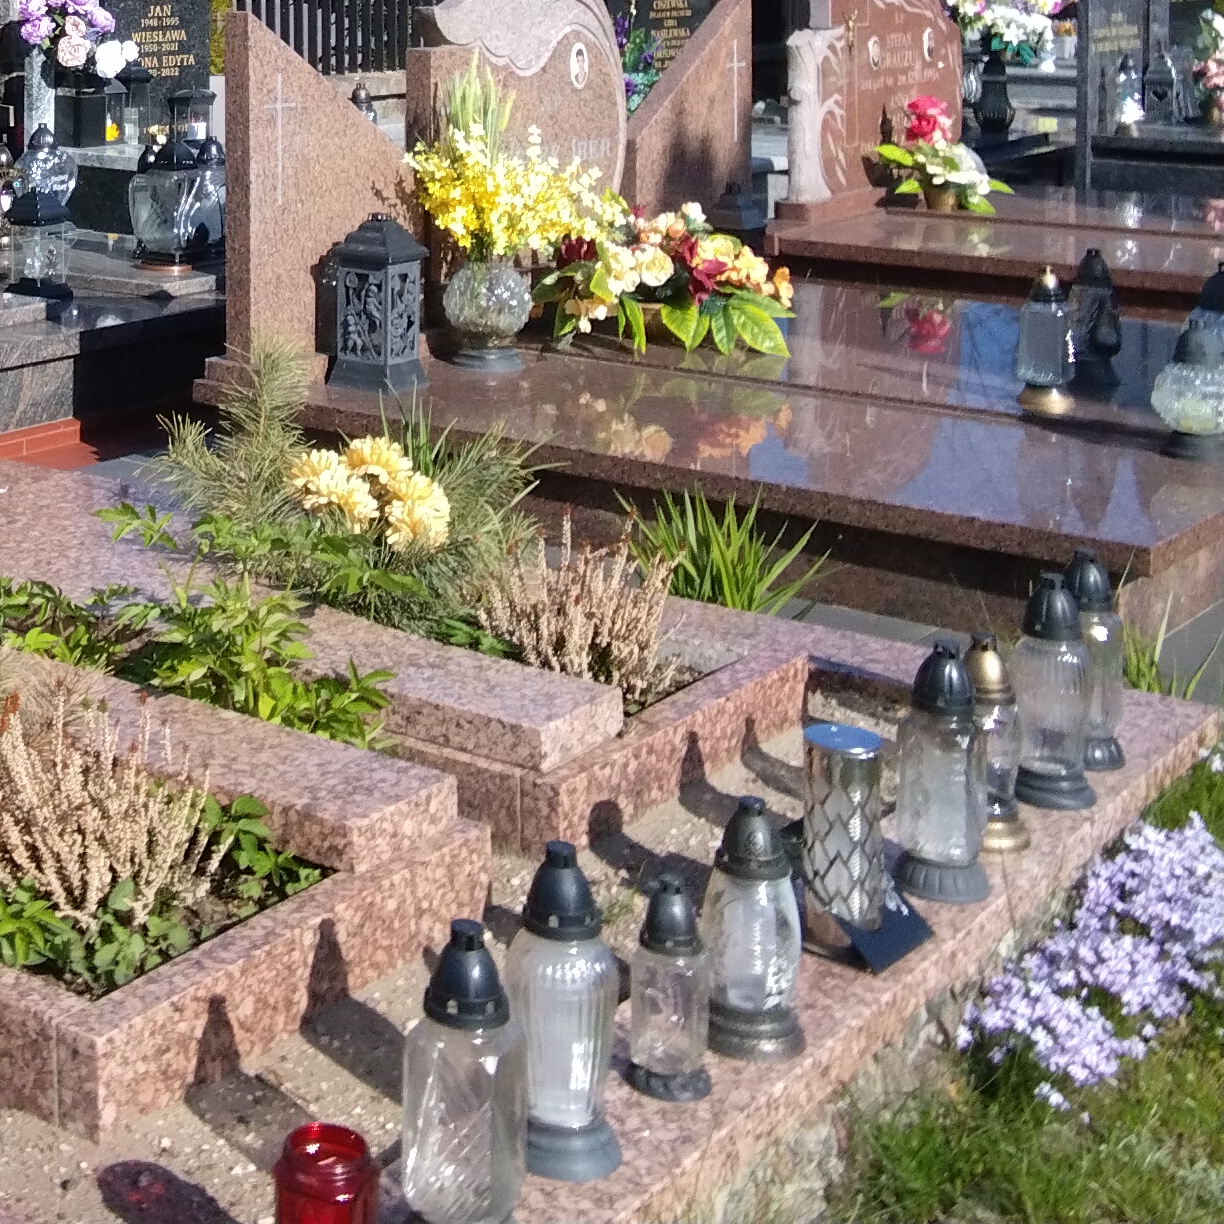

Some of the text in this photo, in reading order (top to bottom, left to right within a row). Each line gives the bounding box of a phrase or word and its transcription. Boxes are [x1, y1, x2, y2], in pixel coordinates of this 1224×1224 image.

[147, 4, 172, 17] JAN
[132, 29, 187, 43] WIESŁAWA
[162, 54, 196, 67] EDYTA
